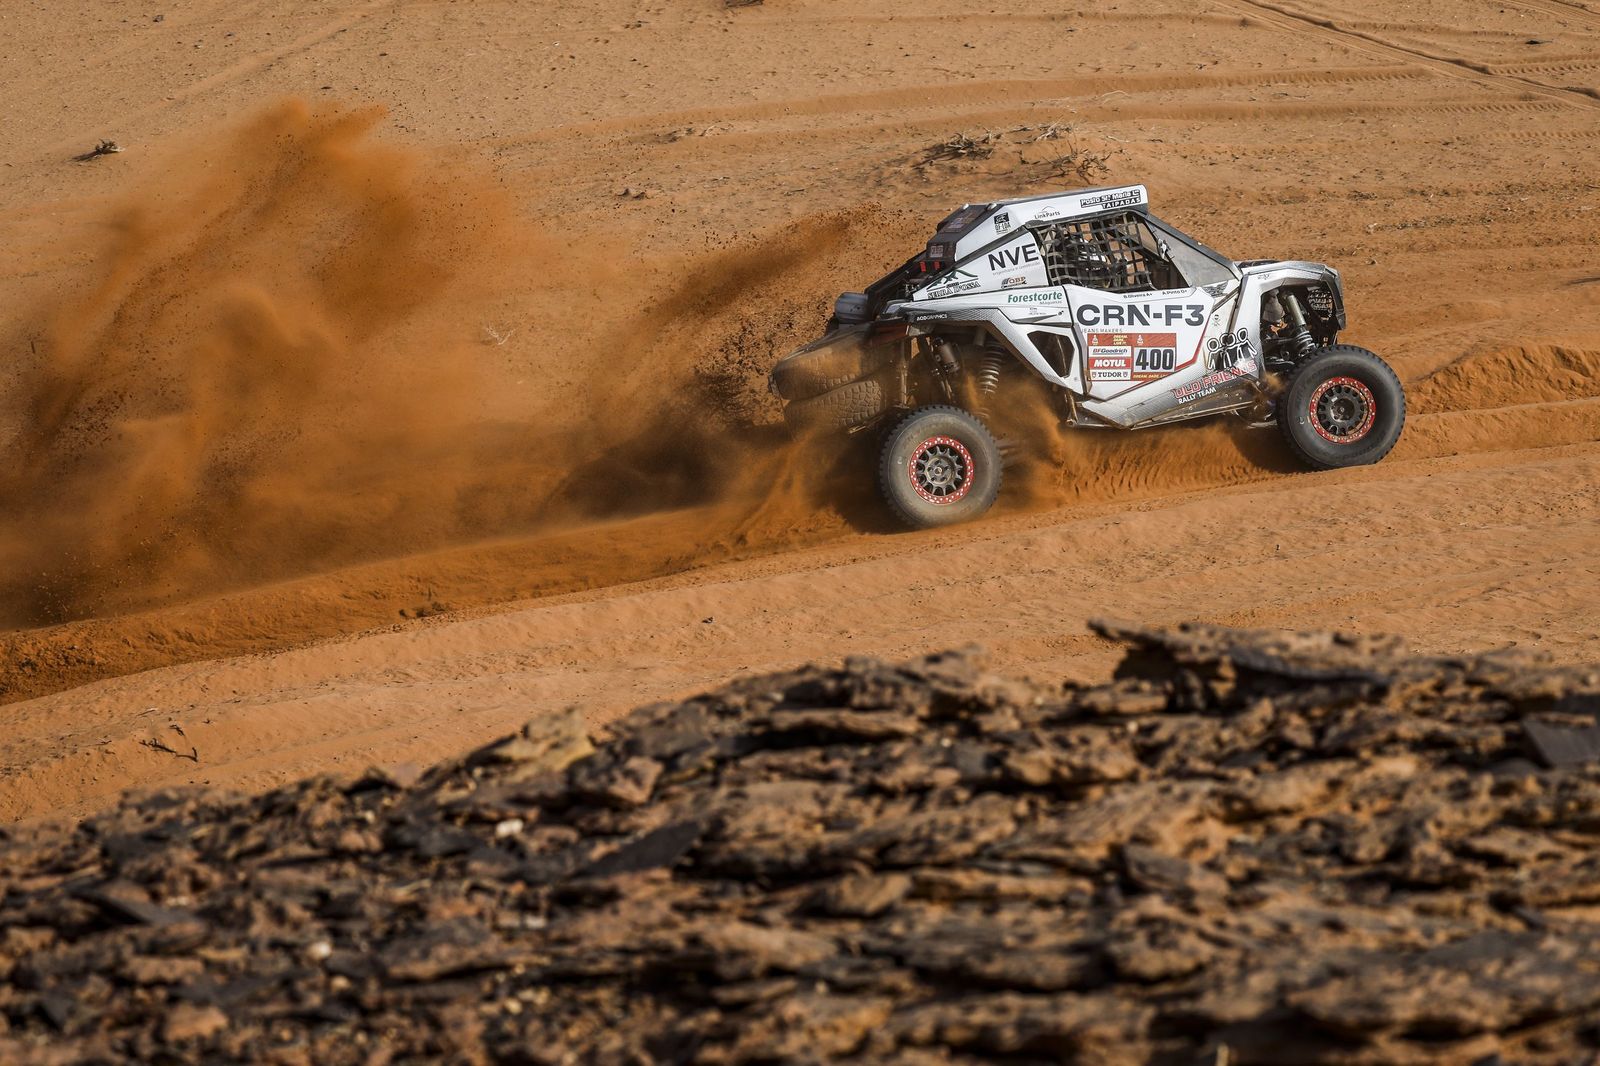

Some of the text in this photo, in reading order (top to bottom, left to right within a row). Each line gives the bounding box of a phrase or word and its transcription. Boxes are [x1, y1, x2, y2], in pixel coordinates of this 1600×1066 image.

[1102, 198, 1140, 208] TAIPADAS
[1034, 212, 1060, 220] LinkParts
[988, 243, 1039, 271] NVE
[1008, 292, 1062, 303] Forestcorte
[1076, 304, 1204, 326] CRN-F3
[1094, 359, 1126, 367] MOTUL
[1136, 348, 1174, 370] 400
[1172, 381, 1202, 398] OLD
[1178, 386, 1216, 404] RALLY TEAM
